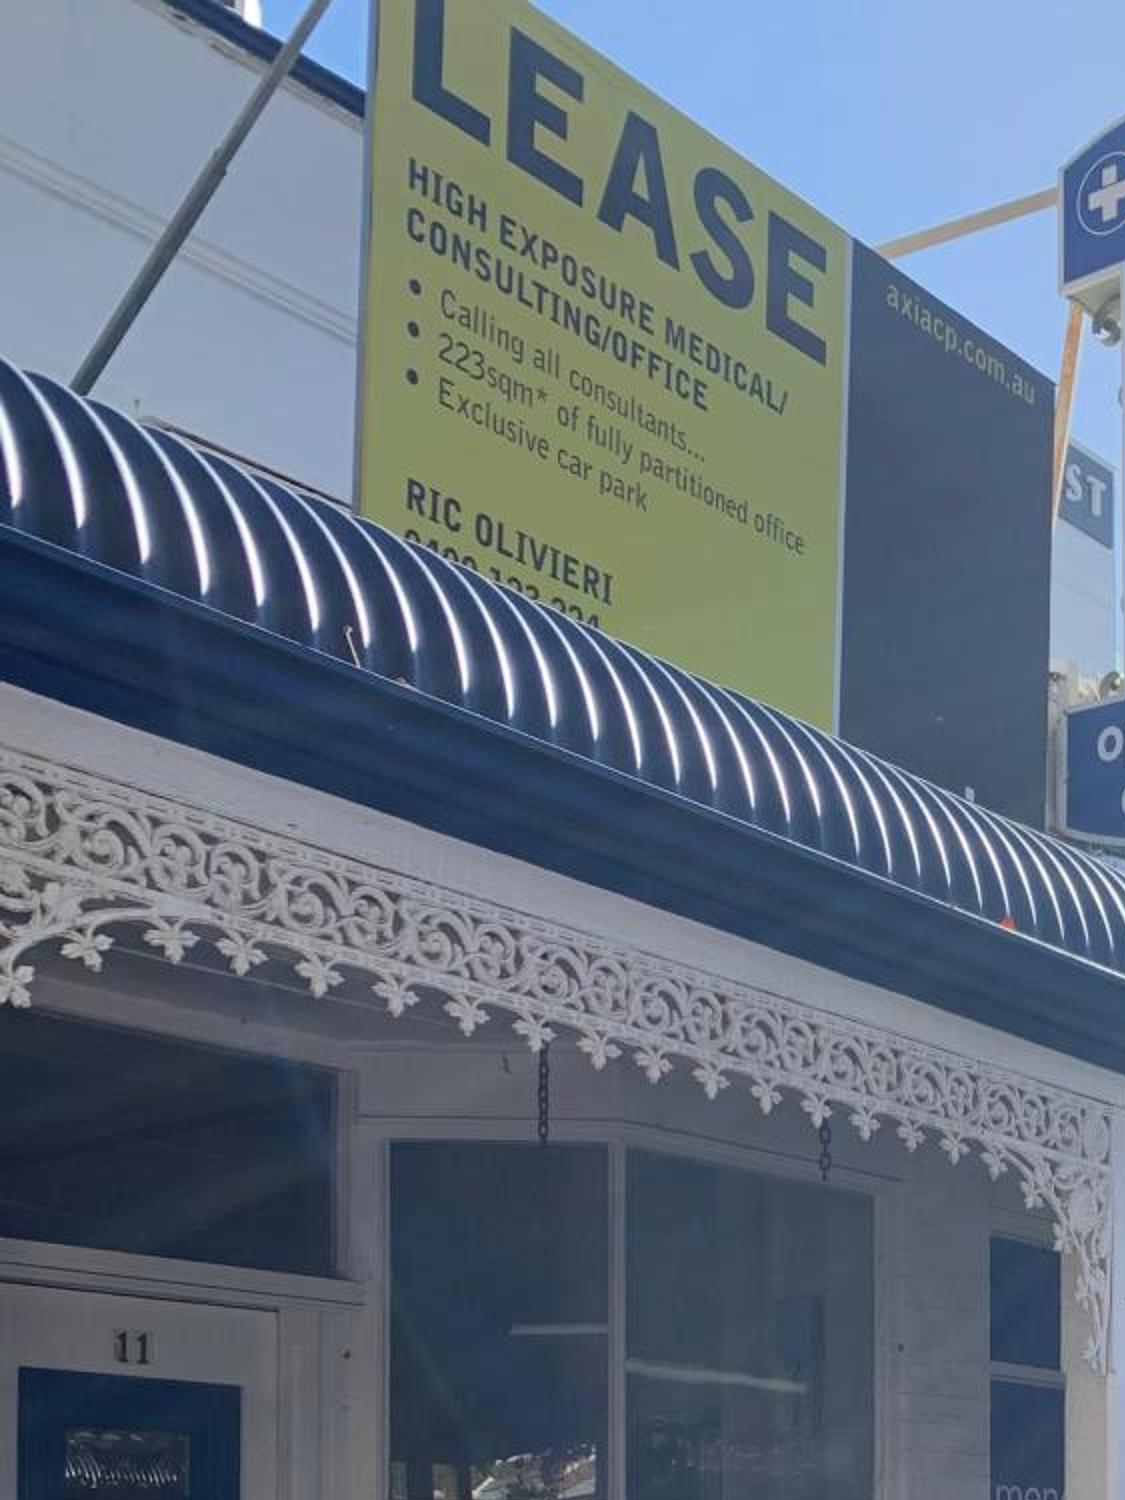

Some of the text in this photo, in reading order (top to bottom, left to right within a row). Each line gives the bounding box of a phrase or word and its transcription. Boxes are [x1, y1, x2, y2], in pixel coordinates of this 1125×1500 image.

[412, 0, 827, 366] LEASE
[407, 207, 708, 412] CONSULTING/OFFICE
[408, 157, 788, 416] HIGH EXPOSURE MEDICAL/
[441, 288, 525, 365] Calling
[533, 347, 560, 380] all
[886, 283, 1036, 405] axiacp.com.au
[438, 375, 648, 513] Exclusive car park
[556, 404, 579, 432] of
[587, 414, 634, 465] fully
[640, 450, 749, 525] partitioned
[753, 512, 806, 556] office
[406, 477, 462, 533] RIC
[475, 512, 614, 606] OLIVIERI
[116, 1331, 151, 1366] 11
